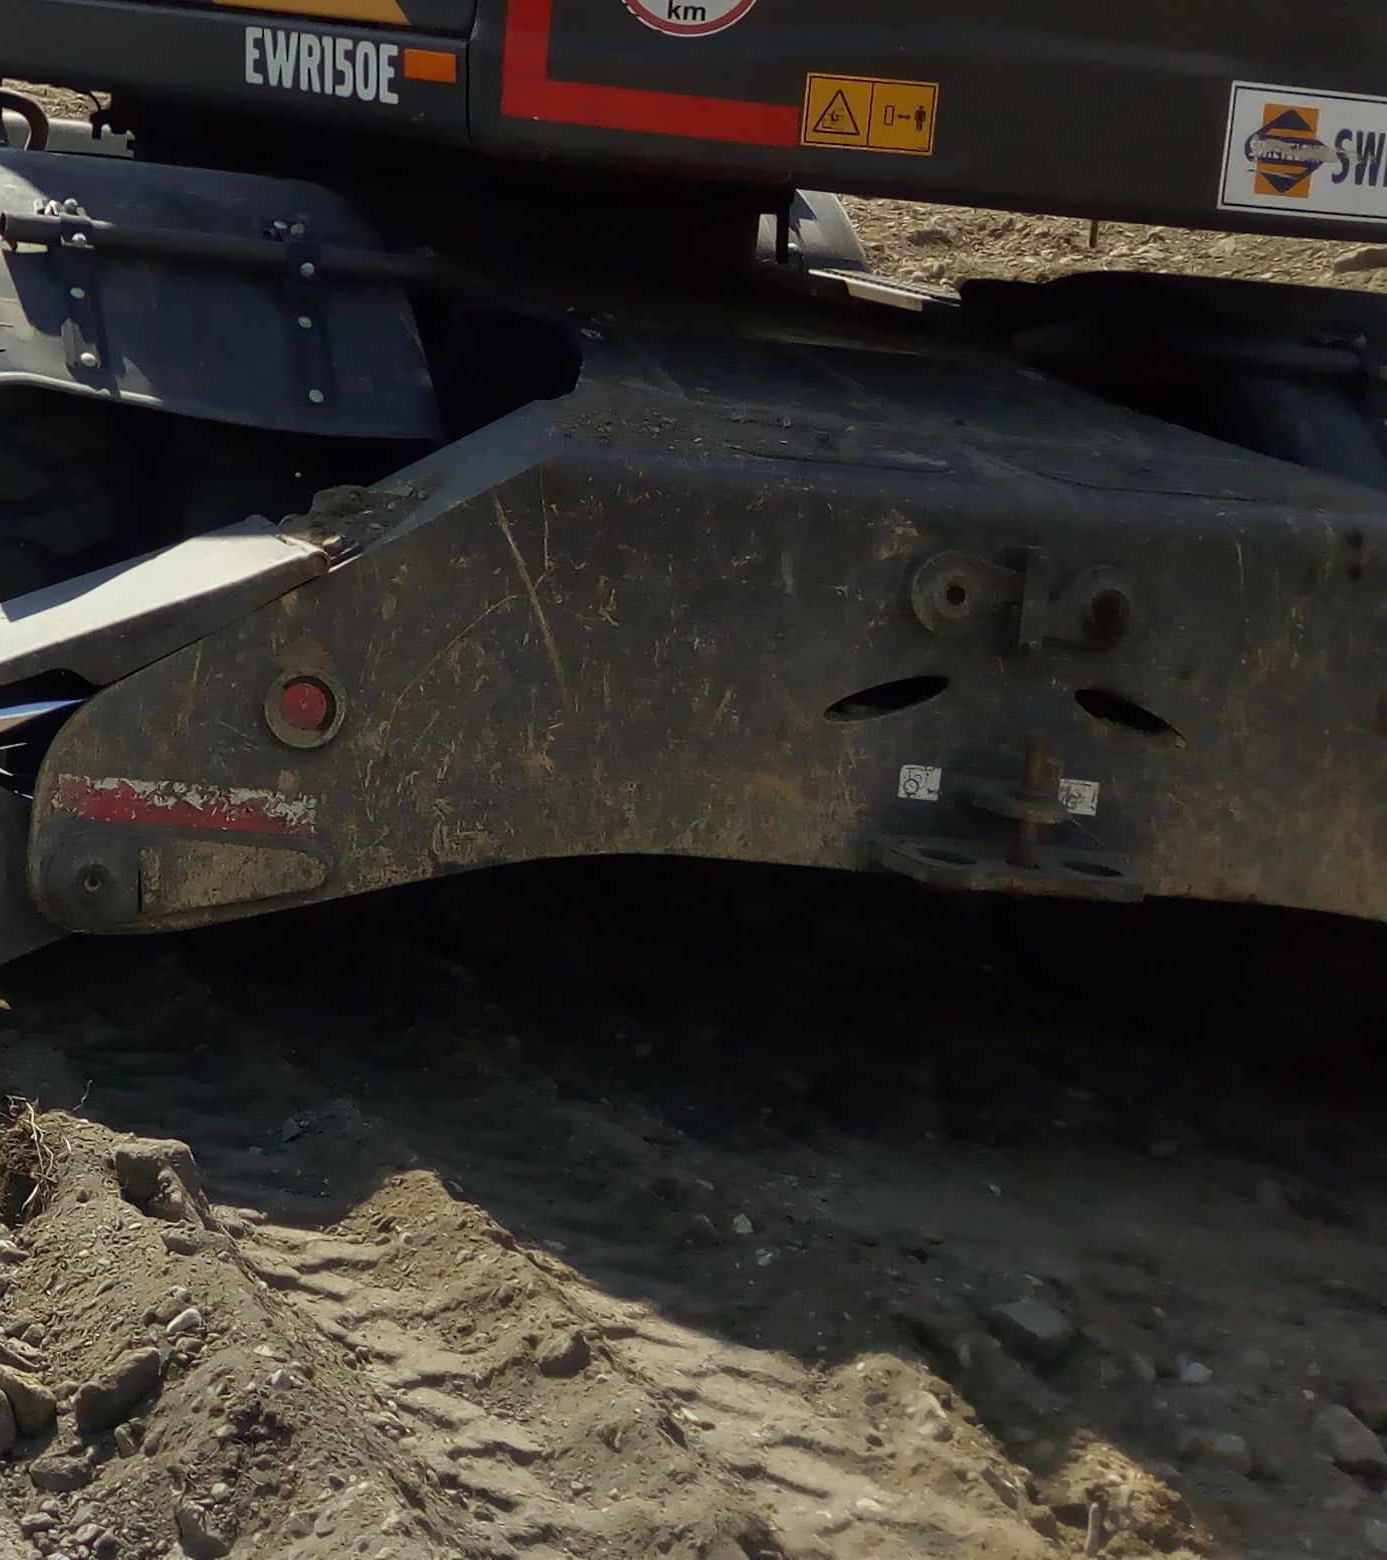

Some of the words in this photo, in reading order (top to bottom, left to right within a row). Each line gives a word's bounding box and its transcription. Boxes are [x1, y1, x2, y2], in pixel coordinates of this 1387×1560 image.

[667, 0, 707, 22] km
[245, 26, 399, 105] EWR150E
[1331, 128, 1387, 188] SW
